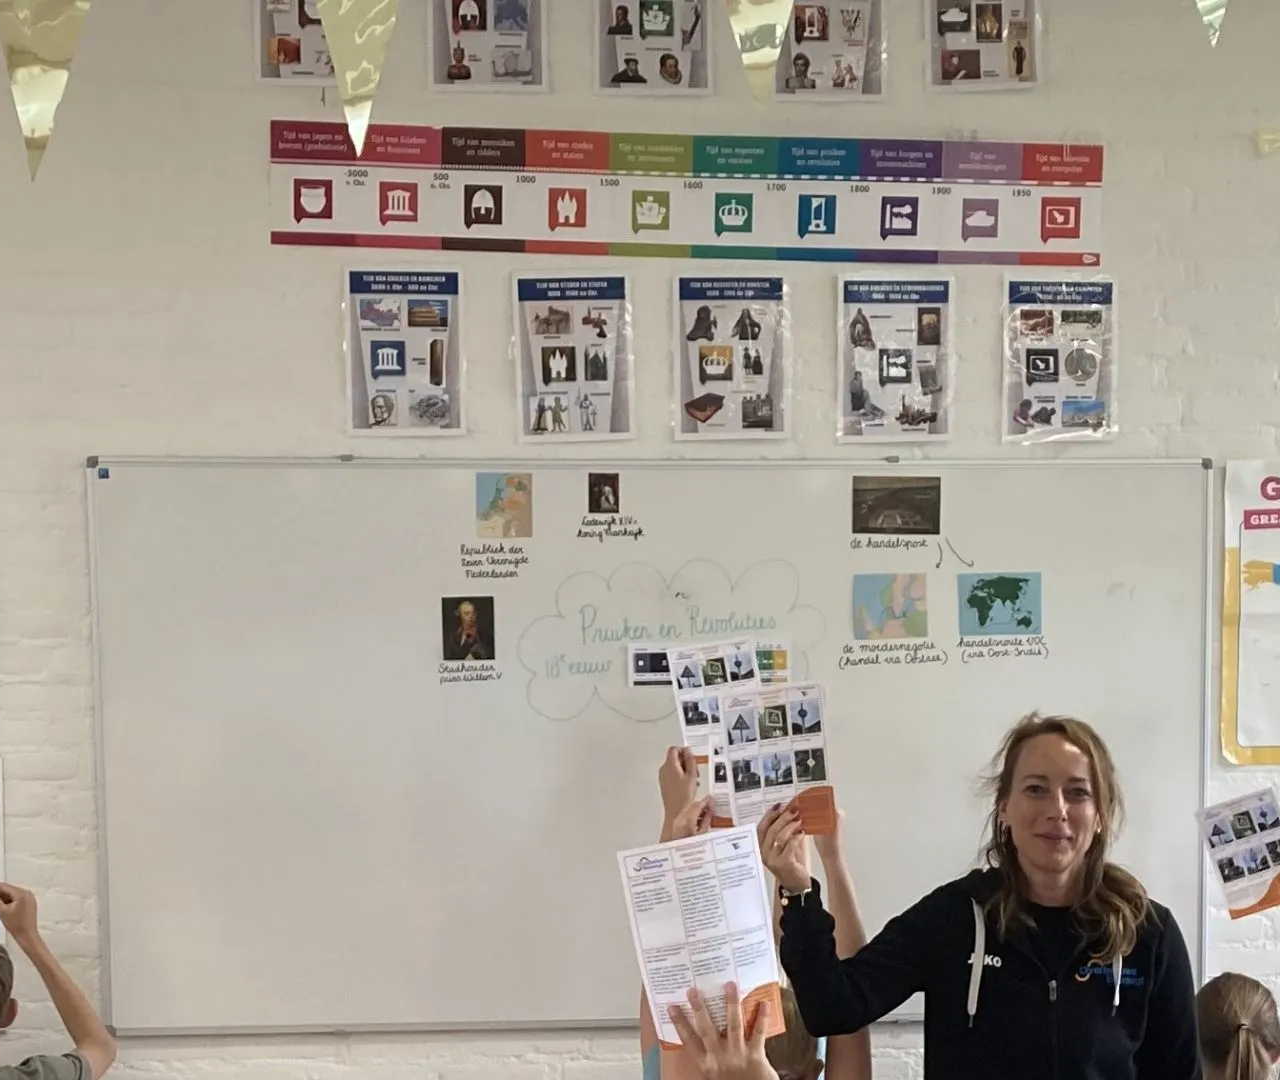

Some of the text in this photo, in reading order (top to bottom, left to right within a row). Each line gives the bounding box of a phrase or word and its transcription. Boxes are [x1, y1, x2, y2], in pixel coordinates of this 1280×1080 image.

[452, 137, 465, 147] Tijd
[432, 173, 449, 181] 500
[516, 175, 536, 183] 1000
[600, 178, 619, 186] 1500
[683, 181, 703, 189] 1600
[767, 183, 786, 191] 1700
[850, 185, 870, 193] 1800
[931, 187, 951, 195] 1900
[1012, 189, 1031, 197] 1950
[581, 516, 617, 528] Lodewijk
[577, 528, 603, 542] koning
[850, 537, 928, 550] de handelspost
[460, 543, 524, 556] Republiek der
[658, 623, 682, 640] en
[687, 604, 777, 637] Revoluties
[957, 636, 1024, 649] handelsroute
[842, 643, 855, 654] de
[838, 655, 880, 670] (handel
[884, 656, 901, 664] via
[961, 650, 986, 664] (via
[438, 663, 496, 675] Stadhouder
[570, 660, 612, 676] eeuw
[463, 672, 495, 682] Willem
[967, 953, 1002, 967] JKO
